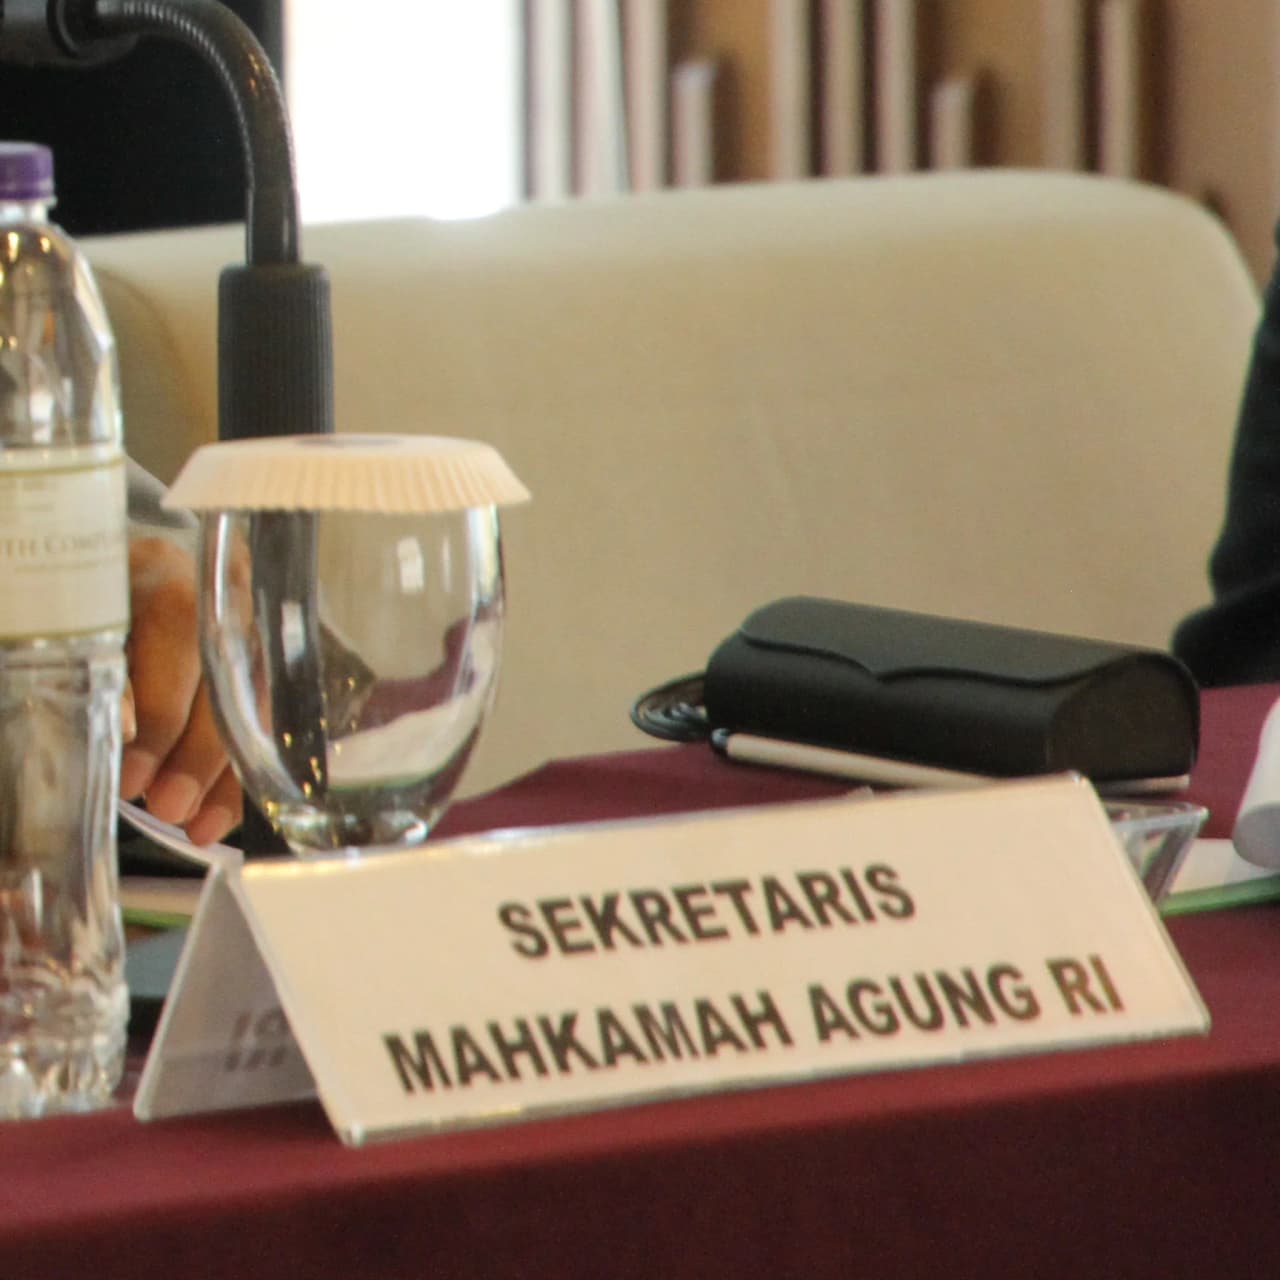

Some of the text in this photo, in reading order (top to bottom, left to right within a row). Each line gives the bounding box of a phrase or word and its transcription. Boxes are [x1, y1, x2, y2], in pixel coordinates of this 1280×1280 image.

[498, 864, 916, 960] SEKRETARIS
[383, 991, 794, 1094] MAHKAMAH
[808, 964, 1041, 1043] AGUNG
[1046, 956, 1124, 1015] RI
